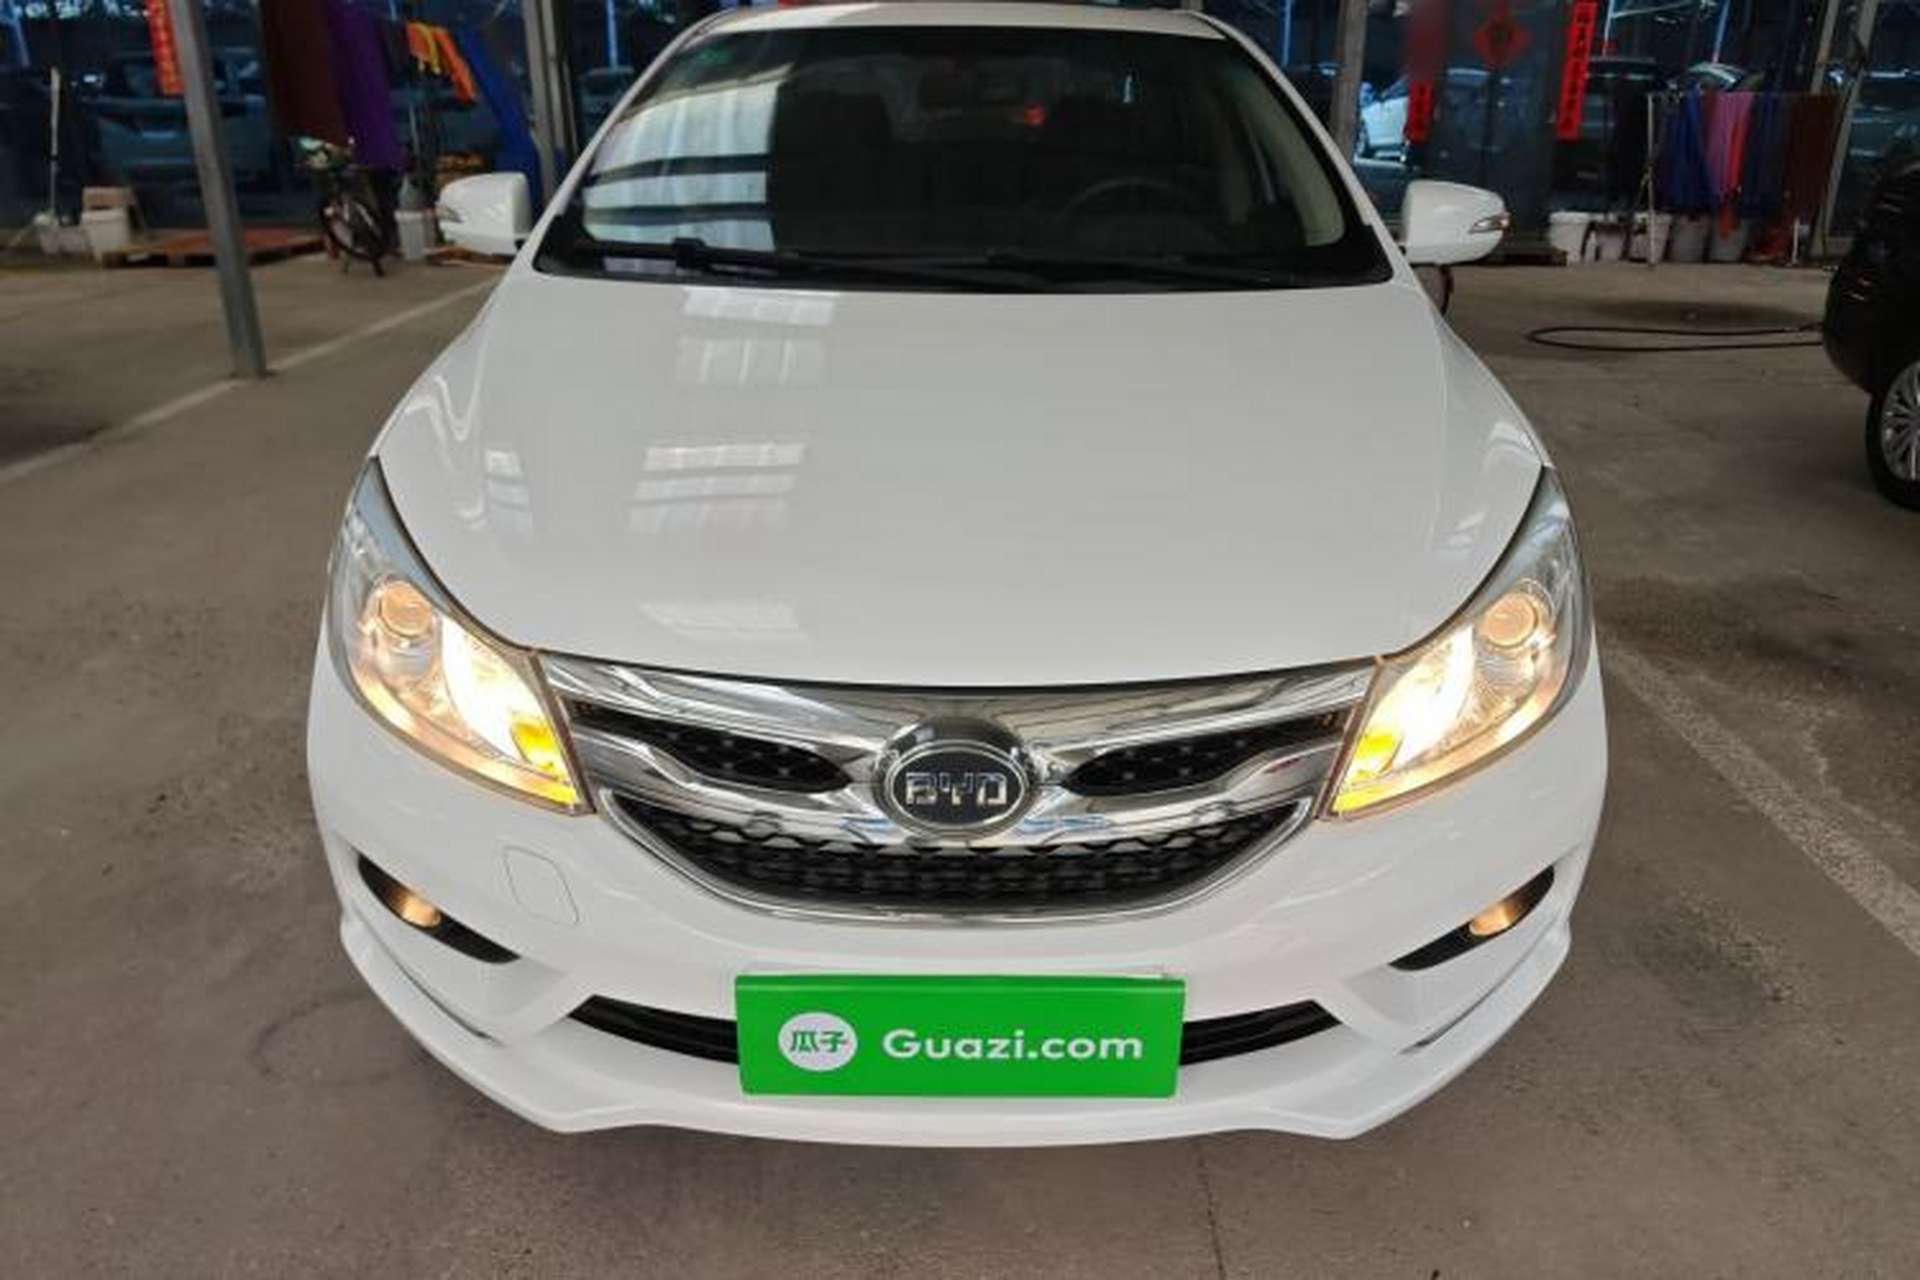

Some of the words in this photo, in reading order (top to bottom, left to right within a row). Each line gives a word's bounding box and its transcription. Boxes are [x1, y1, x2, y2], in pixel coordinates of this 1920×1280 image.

[905, 772, 1007, 805] BYD
[790, 1030, 848, 1053] 瓜子
[882, 1028, 1143, 1060] Guazi.com
